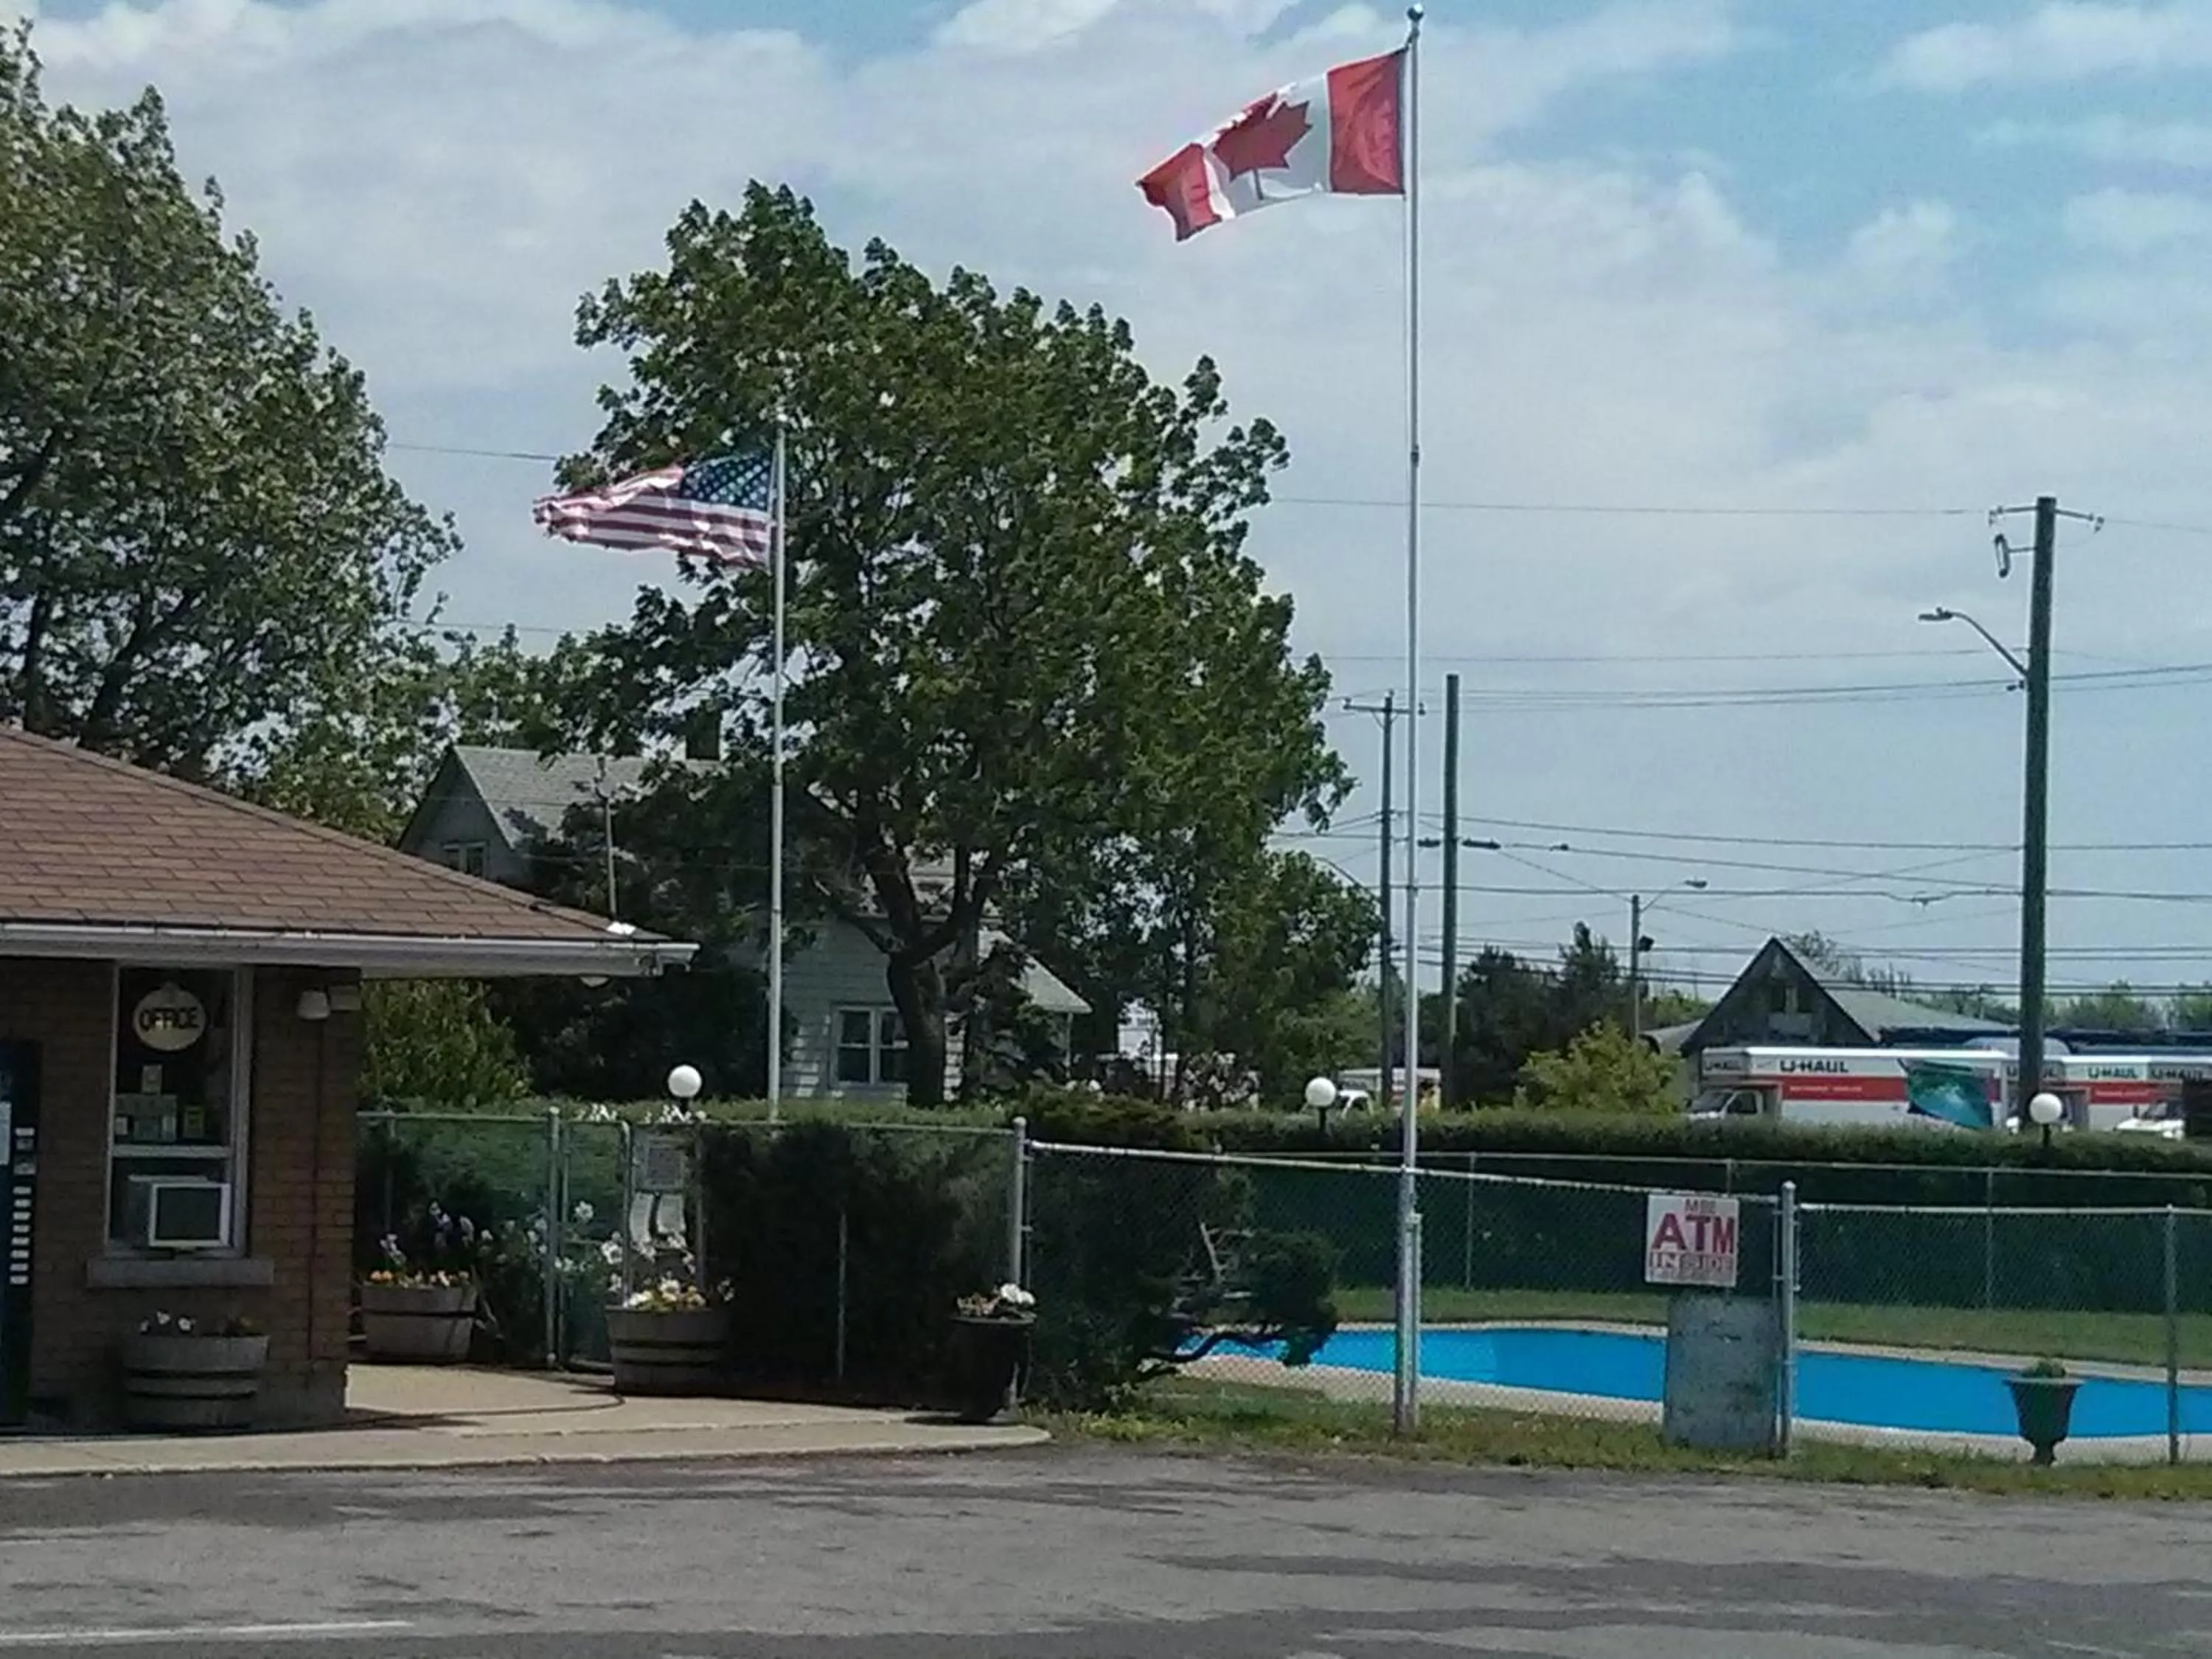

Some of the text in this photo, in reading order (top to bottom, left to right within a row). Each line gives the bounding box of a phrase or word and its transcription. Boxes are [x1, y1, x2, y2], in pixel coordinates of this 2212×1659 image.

[139, 1007, 201, 1031] OFFICE
[1780, 1060, 1849, 1073] U-HAUL
[2087, 1066, 2138, 1079] U-HAUL
[1652, 1213, 1735, 1254] ATM
